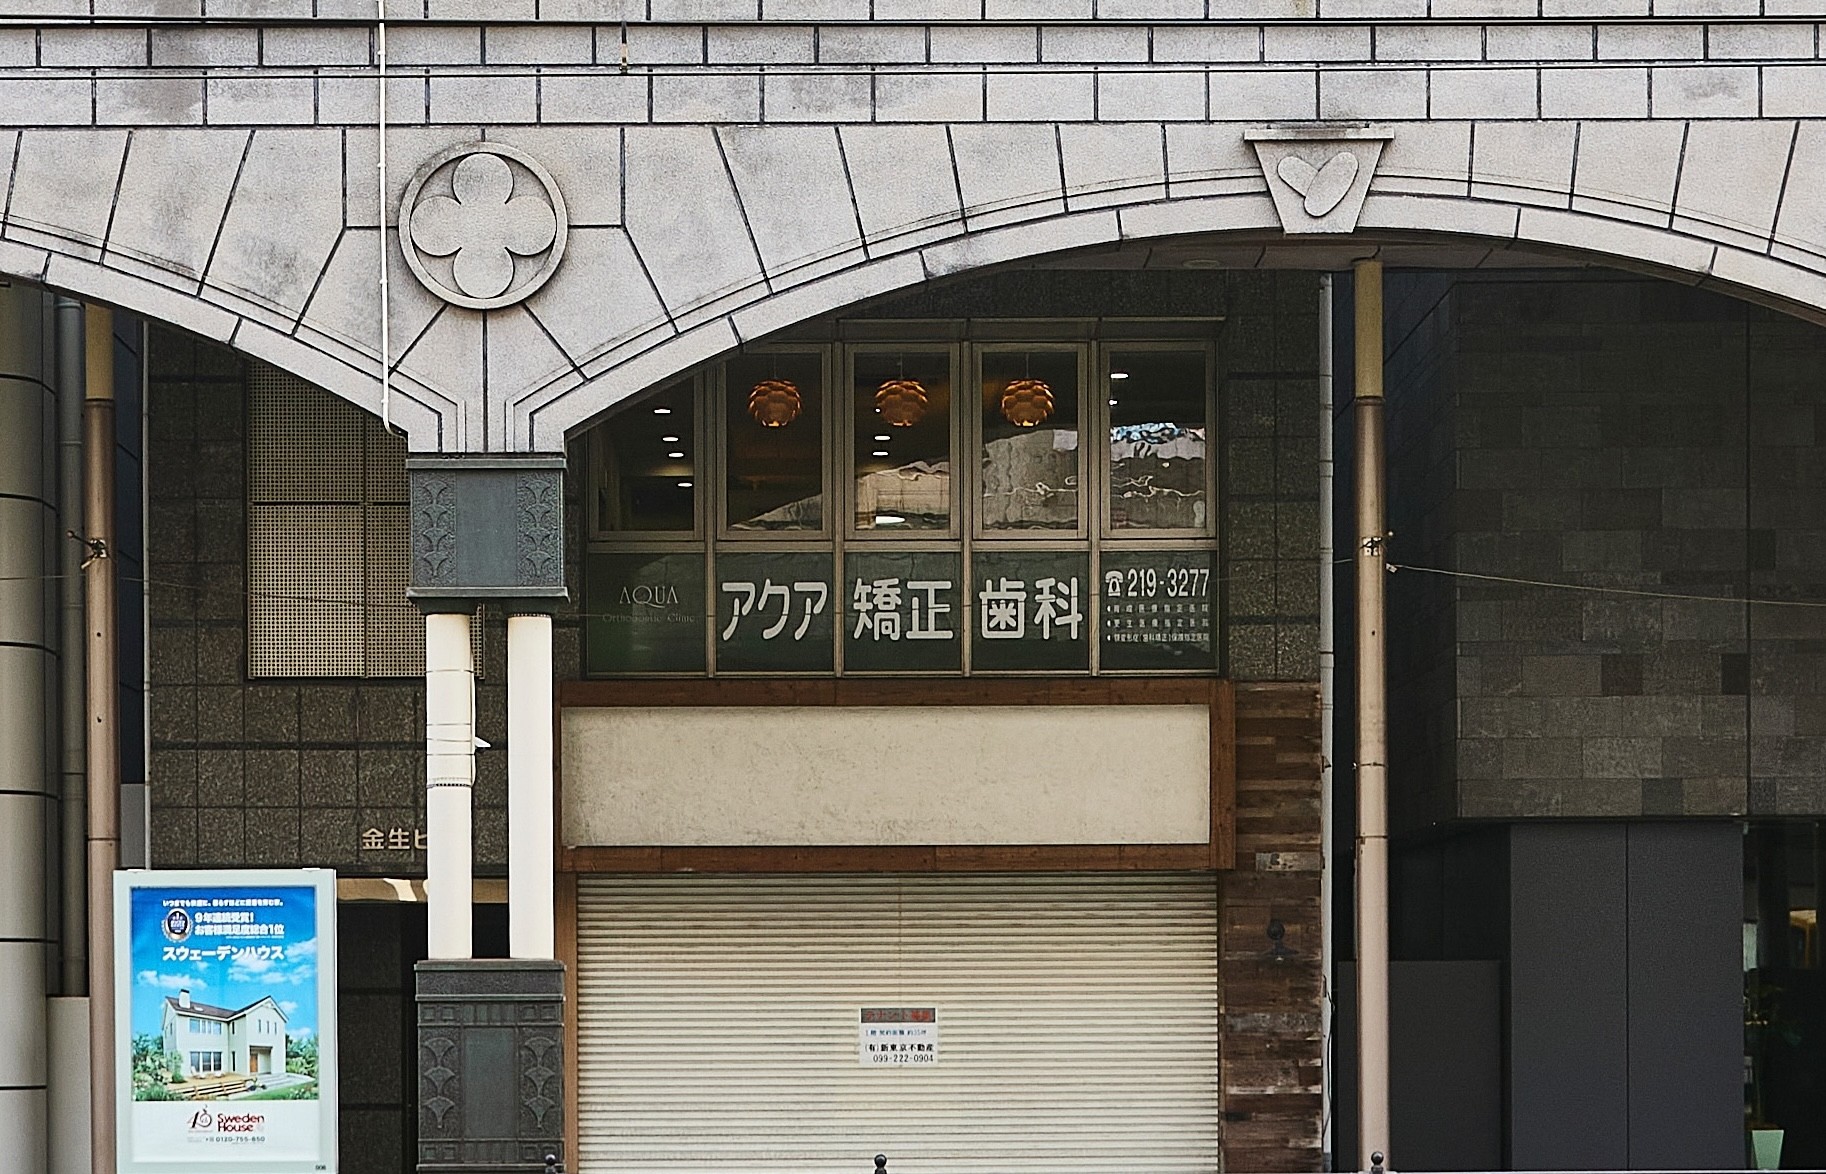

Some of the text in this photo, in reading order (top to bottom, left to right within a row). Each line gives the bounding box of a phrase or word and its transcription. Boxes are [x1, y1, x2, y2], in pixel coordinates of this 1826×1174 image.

[1127, 568, 1210, 597] 219-3277
[619, 585, 679, 609] AQUA
[721, 576, 1083, 642] アクア 矯正 歯科
[667, 613, 695, 623] Clinic
[162, 944, 285, 961] スウェーデンハウス
[873, 1054, 934, 1063] 099-222-0904
[217, 1113, 265, 1124] Sweden
[217, 1121, 254, 1133] House
